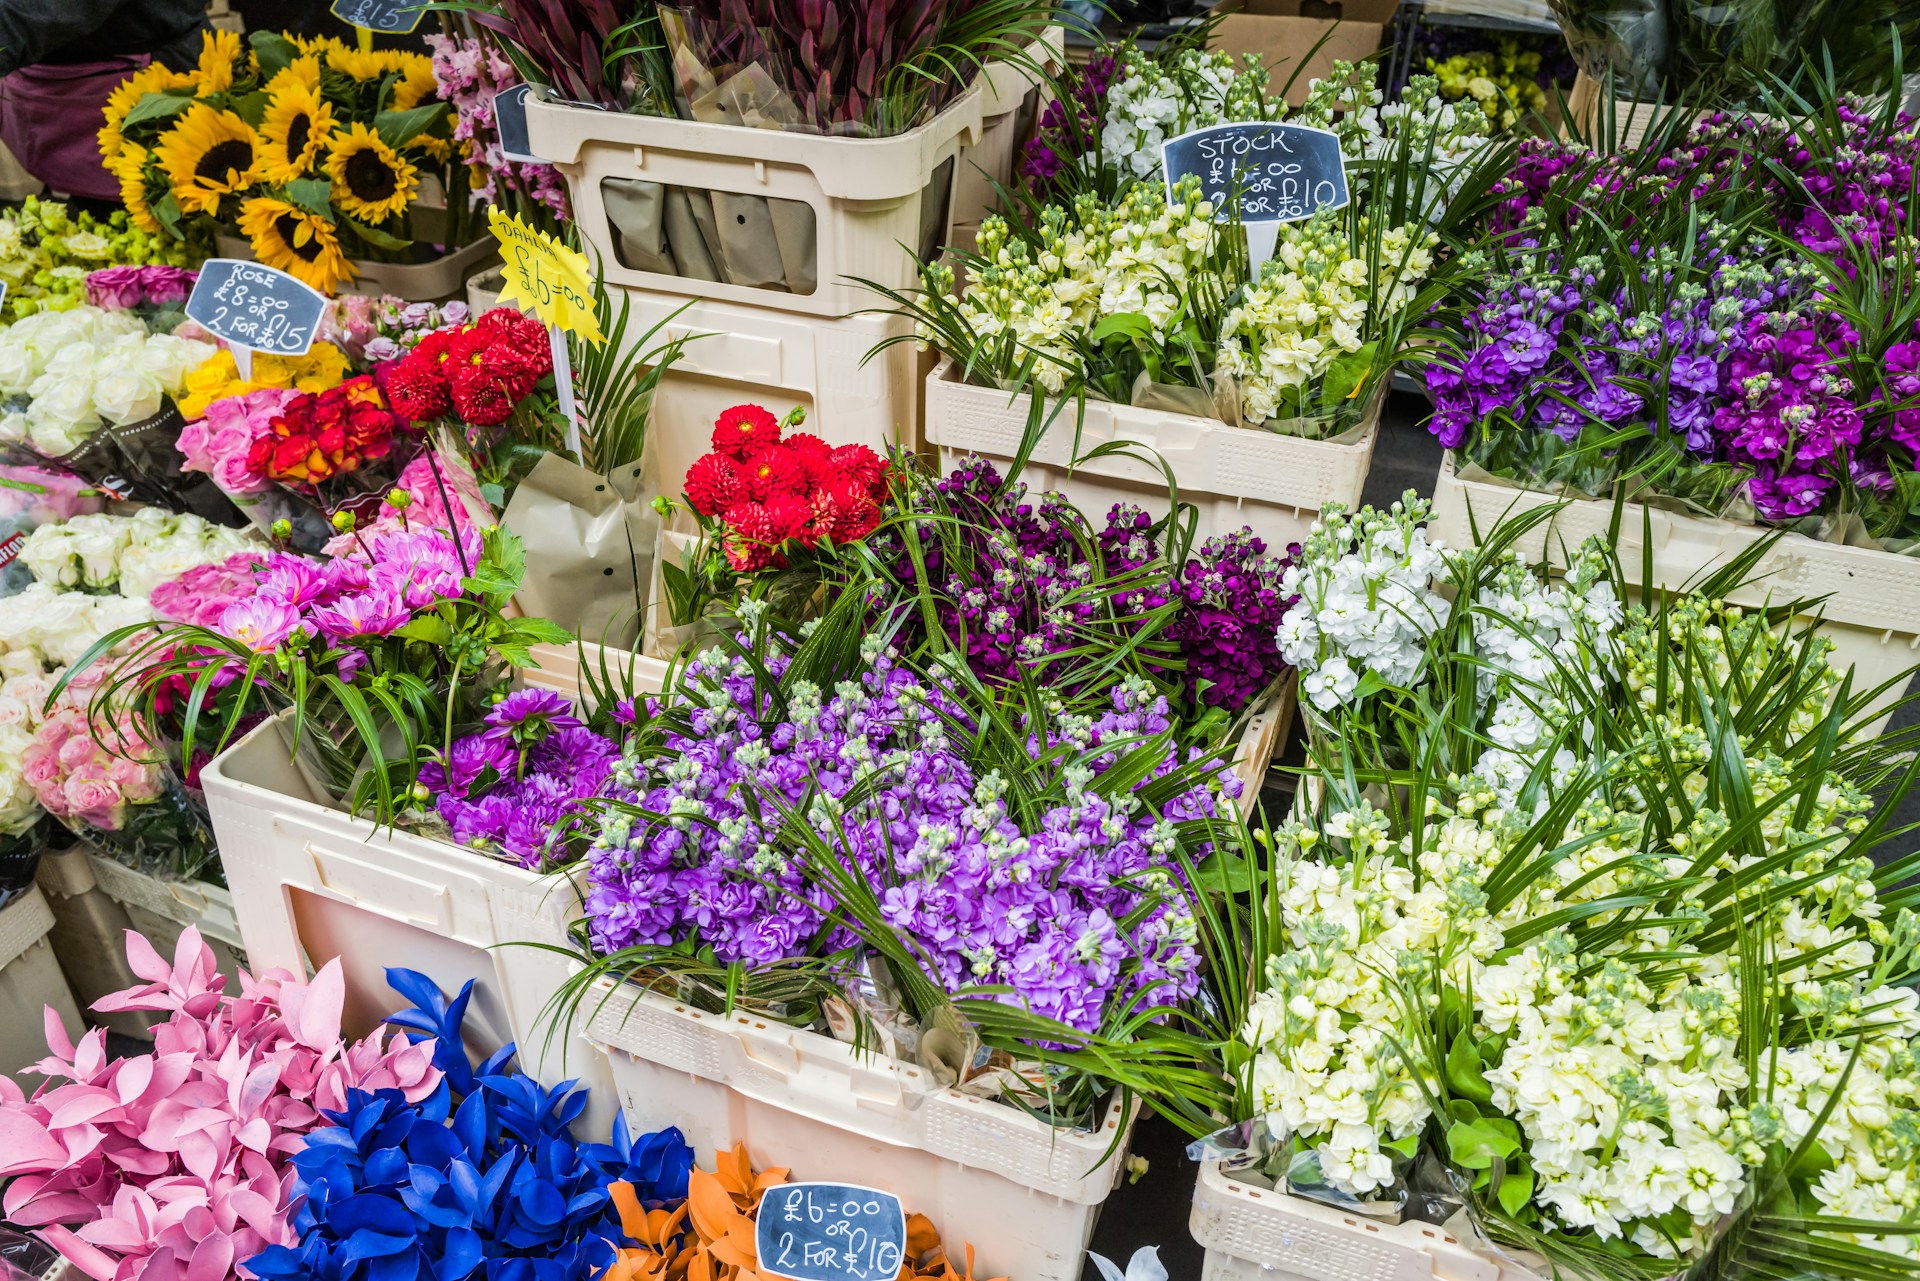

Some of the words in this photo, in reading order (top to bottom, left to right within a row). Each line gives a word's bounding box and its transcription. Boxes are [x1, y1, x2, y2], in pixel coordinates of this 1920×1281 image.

[1197, 130, 1294, 159] STOCK
[1210, 191, 1229, 218] 2
[1232, 196, 1276, 213] FOR
[1277, 177, 1336, 218] £10
[1250, 177, 1277, 193] OR
[498, 221, 559, 262] DAHLIA
[229, 263, 278, 289] ROSE
[248, 305, 268, 321] OR
[207, 306, 228, 331] 2
[229, 316, 259, 338] FOR
[255, 313, 308, 350] £15
[963, 412, 1022, 435] STICKE
[825, 1219, 852, 1237] OR
[776, 1231, 797, 1269] 2
[804, 1240, 842, 1269] FOR
[842, 1227, 902, 1279] £10
